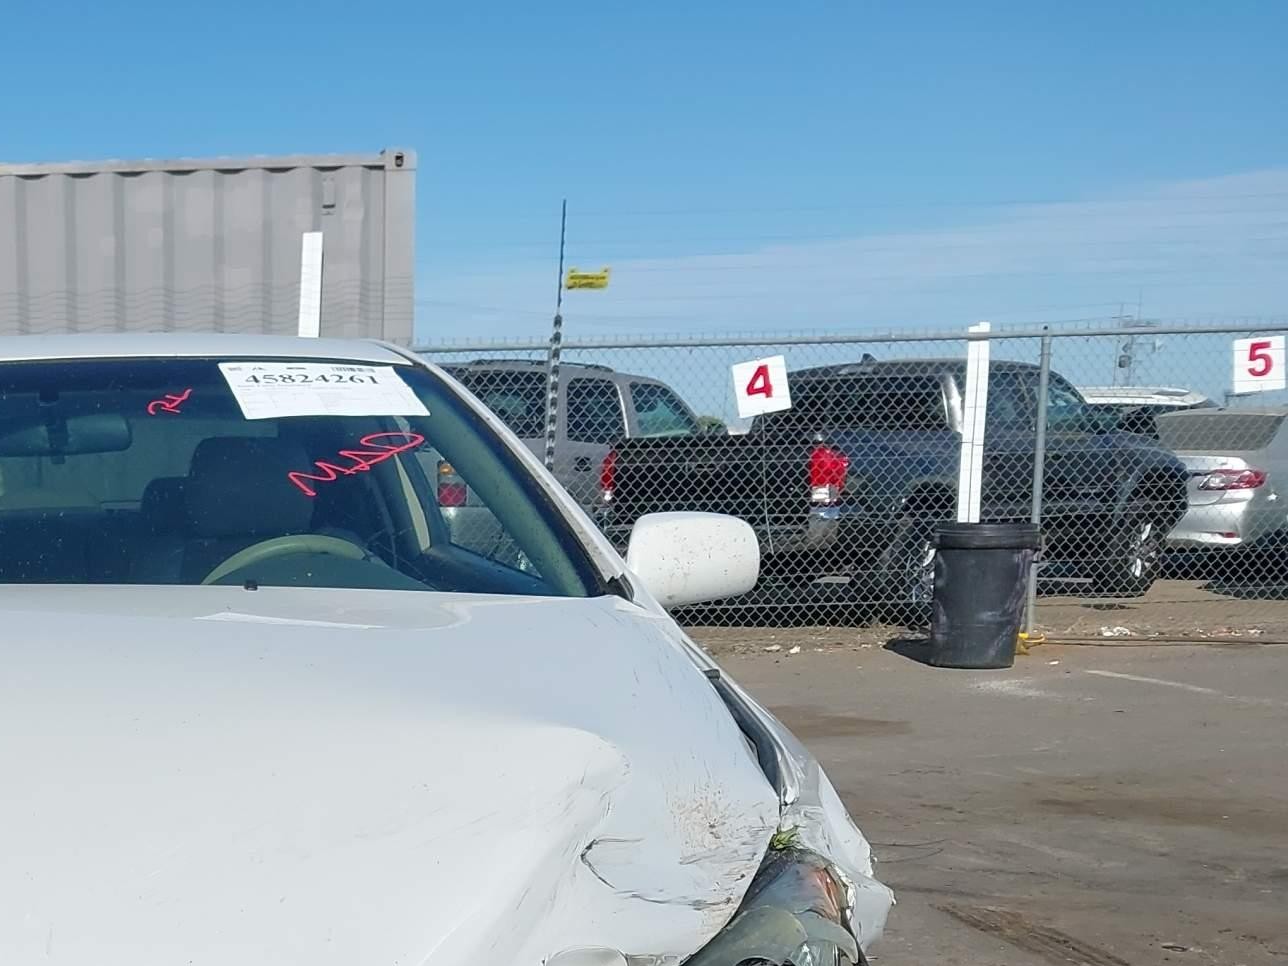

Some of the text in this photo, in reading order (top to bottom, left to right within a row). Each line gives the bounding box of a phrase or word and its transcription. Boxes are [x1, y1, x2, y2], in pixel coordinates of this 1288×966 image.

[1248, 341, 1273, 377] 5
[245, 373, 381, 385] 45824261
[746, 364, 773, 398] 4
